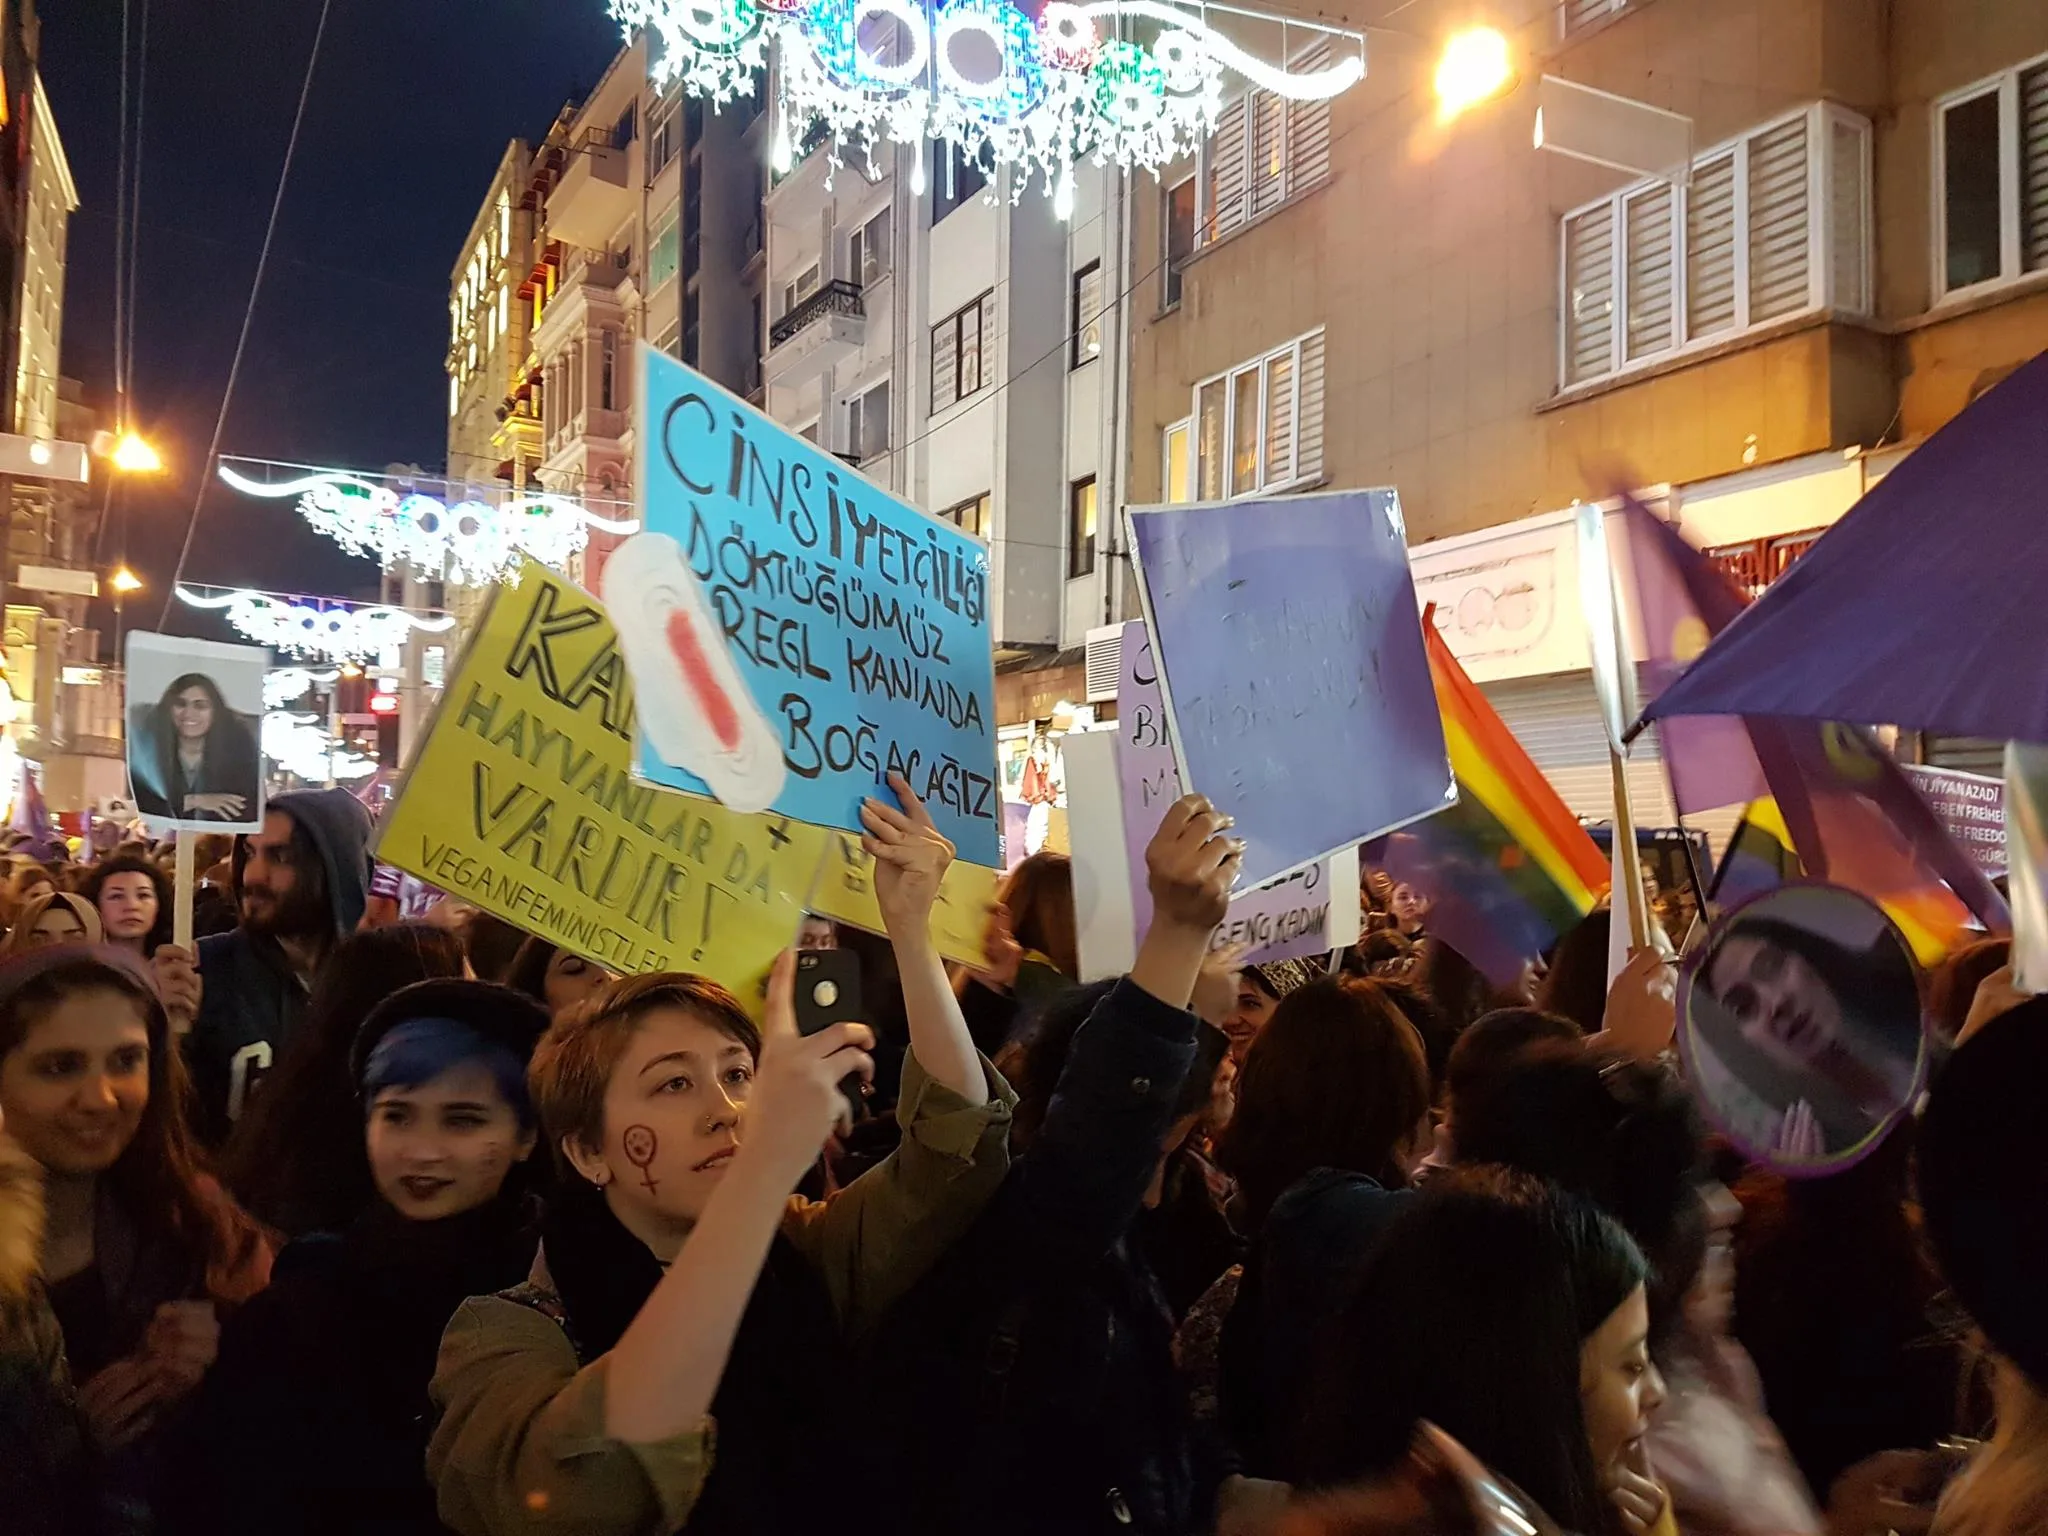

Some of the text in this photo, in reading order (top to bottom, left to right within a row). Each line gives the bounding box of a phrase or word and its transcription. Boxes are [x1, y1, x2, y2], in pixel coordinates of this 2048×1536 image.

[688, 500, 950, 665] DÖKTÜĞÜMÜZ
[711, 584, 984, 736] REGL KANINDA
[456, 681, 714, 865] HAYVANLAR
[721, 841, 771, 904] DA
[1965, 825, 2008, 844] FREEDO
[1209, 911, 1271, 953] GENÇ
